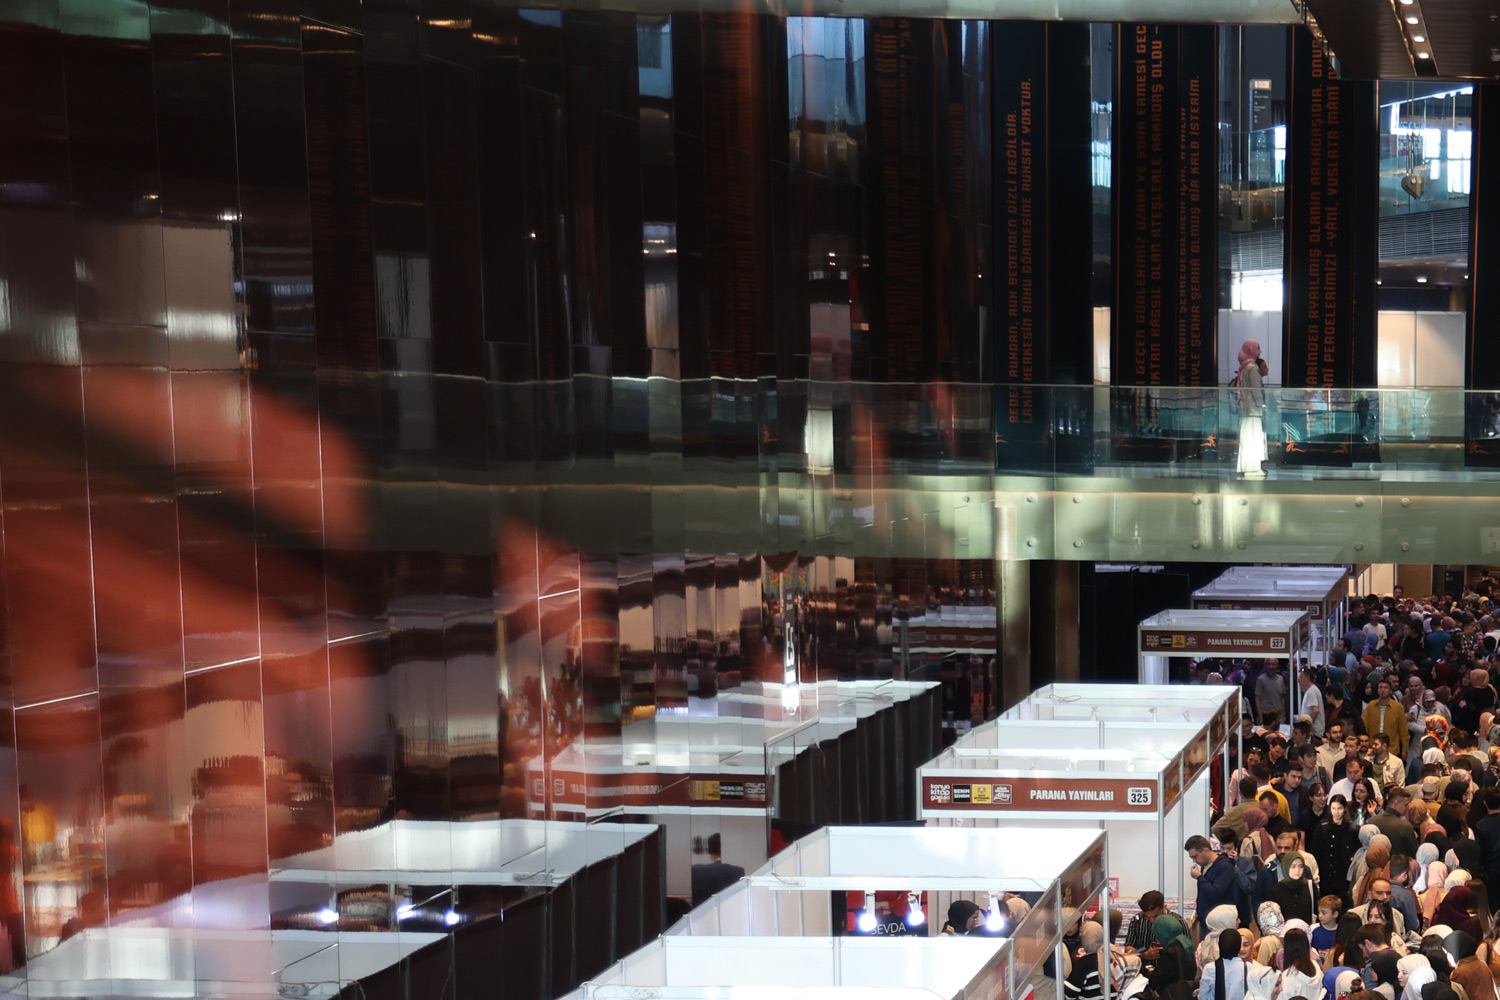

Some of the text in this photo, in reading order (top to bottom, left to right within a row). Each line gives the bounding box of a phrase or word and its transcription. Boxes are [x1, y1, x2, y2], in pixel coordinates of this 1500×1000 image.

[1151, 40, 1163, 78] OLDU
[1021, 77, 1032, 135] YOKTUR.
[1188, 76, 1200, 136] İSTERİM.
[1021, 139, 1032, 192] RUHSAT
[1327, 127, 1339, 196] VUSLATA
[1207, 638, 1232, 646] PANAMA
[1272, 640, 1283, 648] 327
[1030, 789, 1114, 801] PARANA YAYINLARI
[1130, 793, 1148, 803] 325
